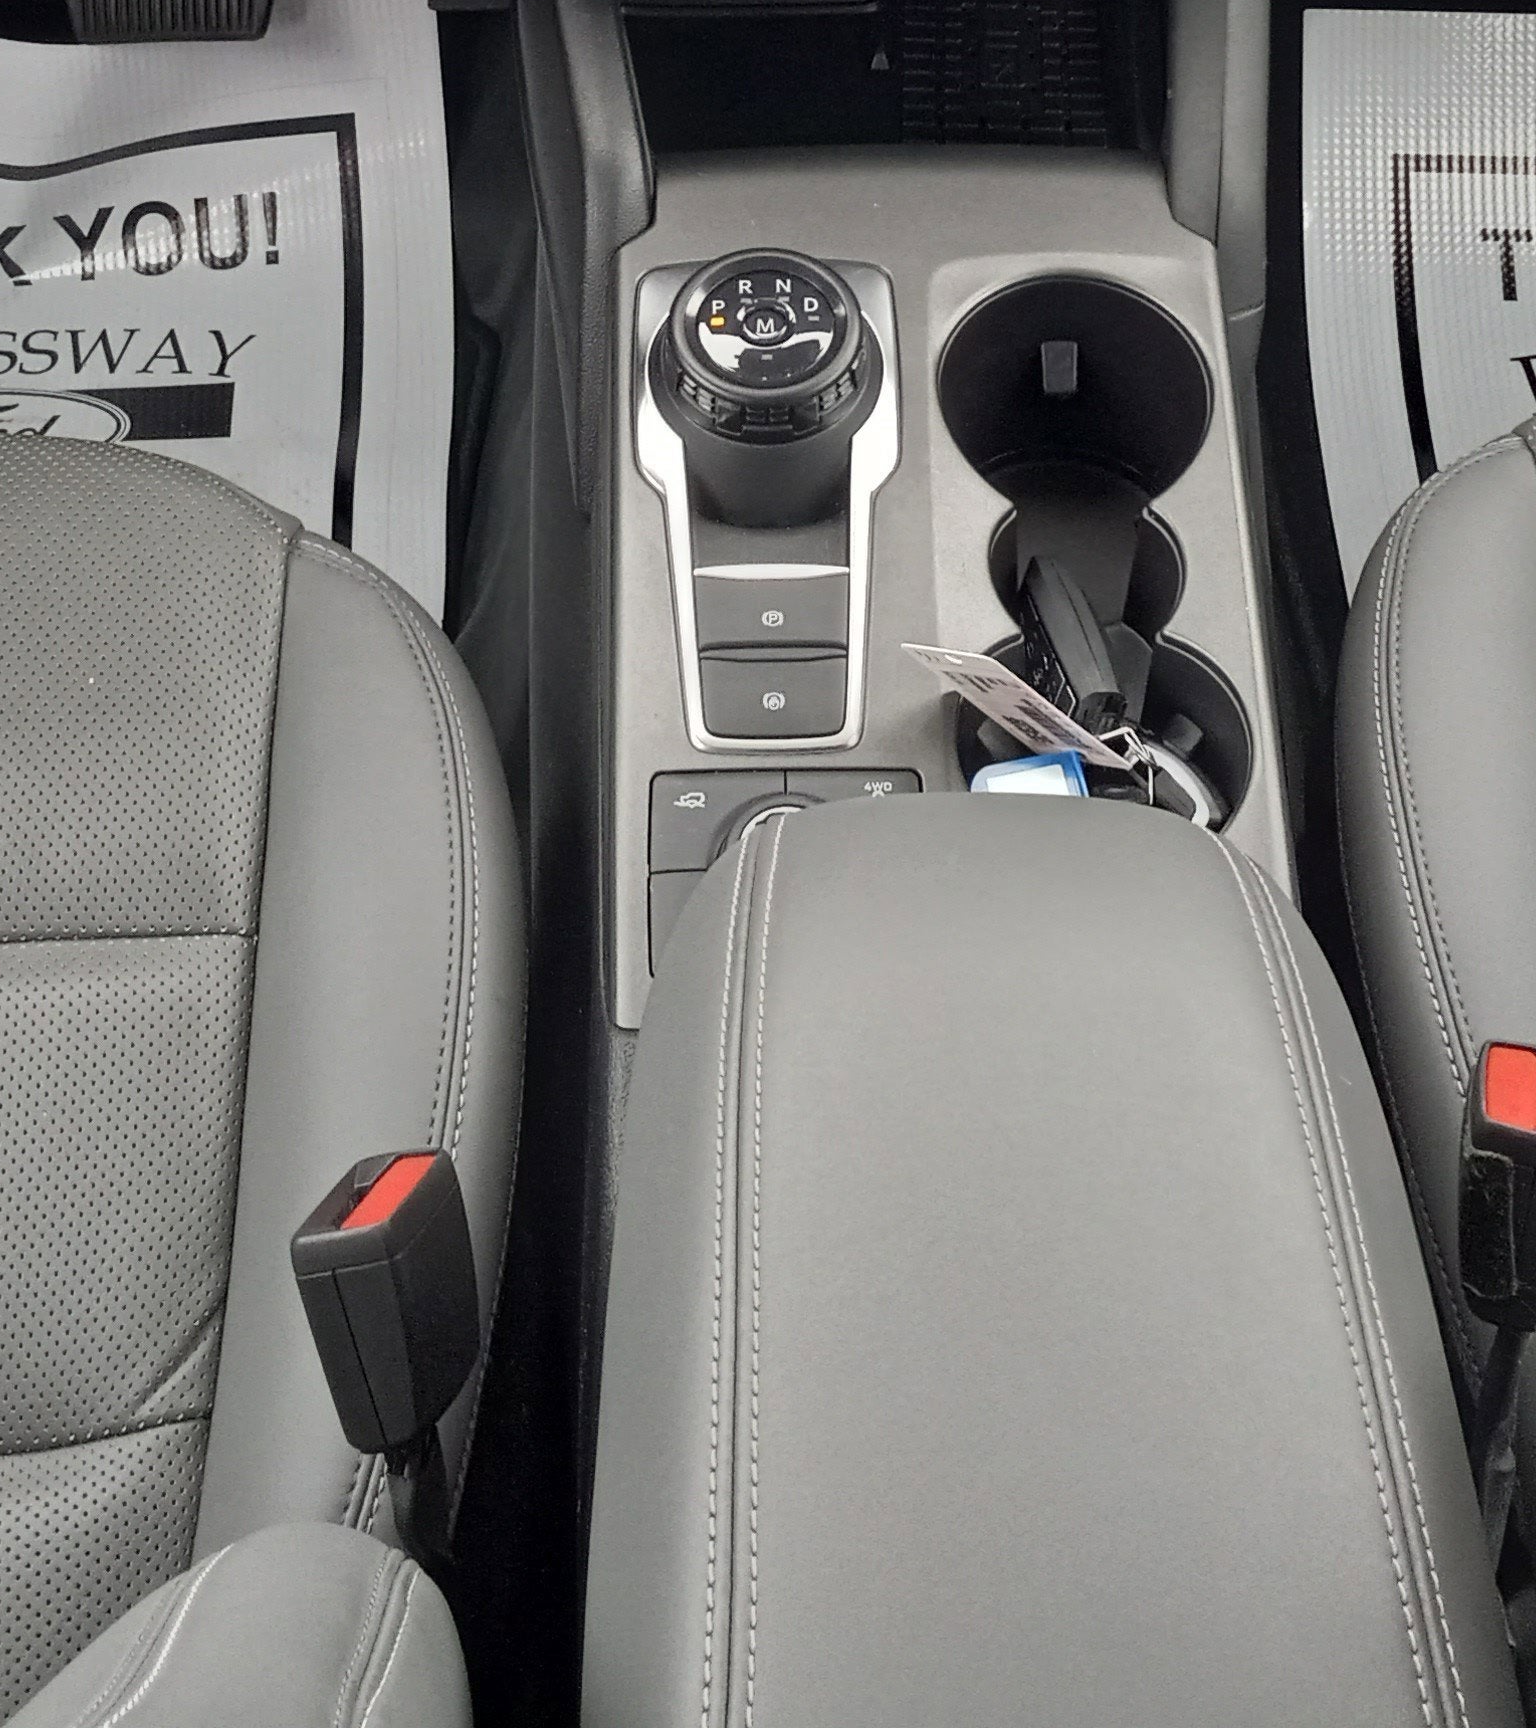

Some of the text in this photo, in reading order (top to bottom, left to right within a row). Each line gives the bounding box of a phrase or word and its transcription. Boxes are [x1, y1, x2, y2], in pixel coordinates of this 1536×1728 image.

[53, 191, 280, 282] YOU!
[739, 280, 753, 294] R
[776, 279, 791, 293] N
[712, 300, 725, 314] P
[804, 297, 819, 312] D
[756, 318, 775, 333] M
[864, 781, 892, 793] 4WD
